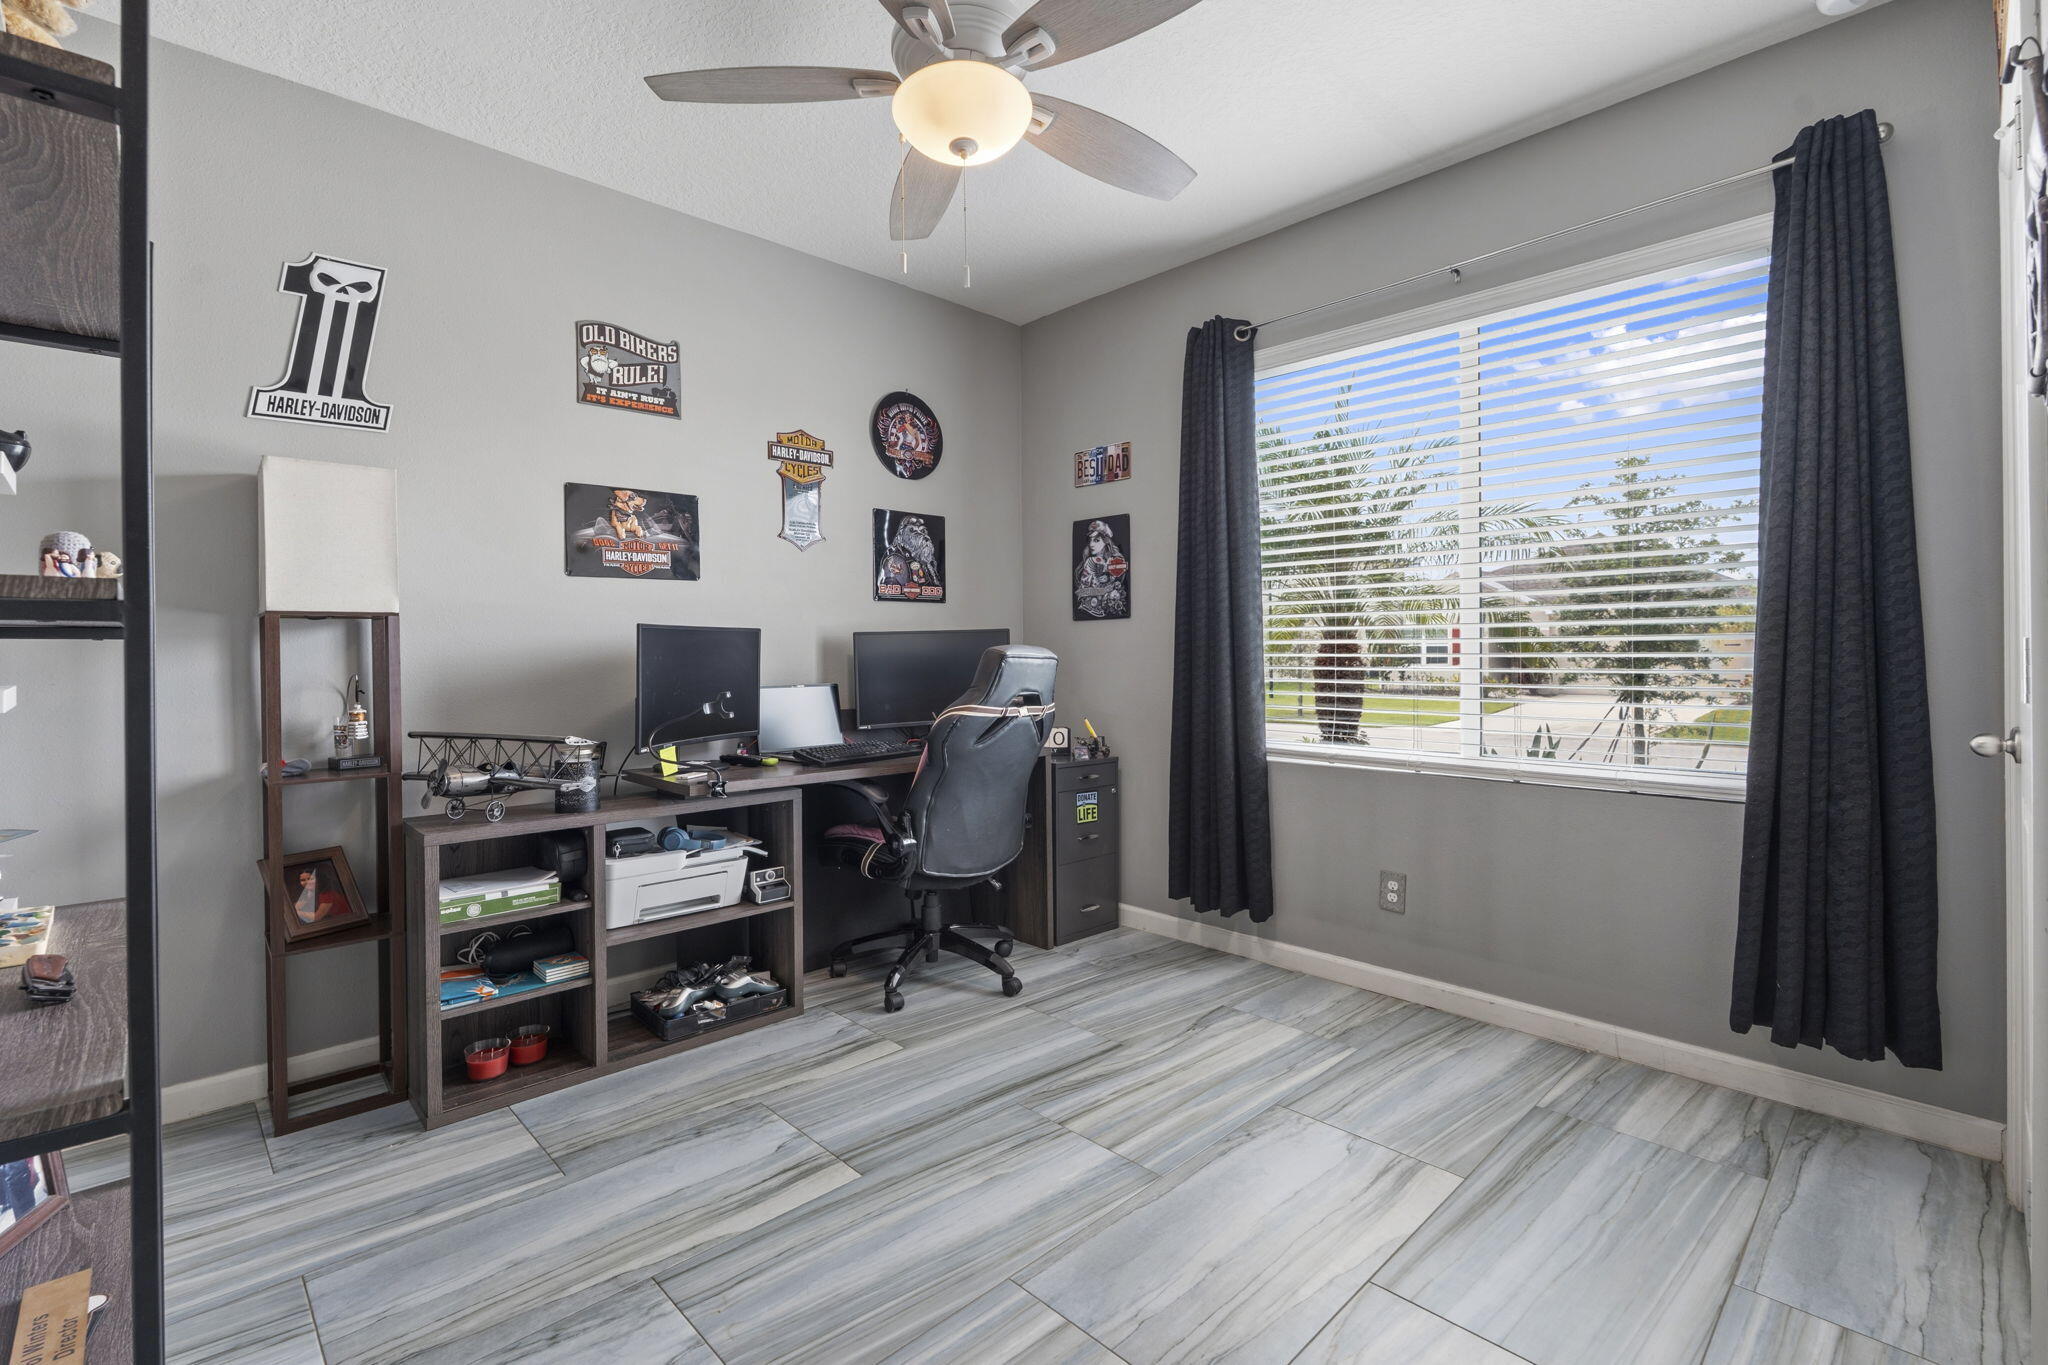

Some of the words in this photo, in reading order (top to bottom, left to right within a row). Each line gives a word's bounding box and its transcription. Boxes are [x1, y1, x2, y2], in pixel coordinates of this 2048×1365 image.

[582, 324, 616, 345] OLD
[619, 329, 678, 362] BIKERS
[612, 365, 664, 385] RULE!
[586, 394, 606, 403] IT'S
[609, 398, 674, 414] EXPERIENCE
[596, 387, 607, 396] IT
[610, 389, 638, 400] AIN'T
[640, 395, 665, 405] RUST
[267, 395, 381, 425] HARLEY-DAVIDSON
[787, 433, 818, 448] MOTOR
[772, 445, 830, 465] HARLEY-DAVIDSON
[784, 462, 819, 478] CYCLES
[1077, 454, 1104, 479] BEST
[1107, 453, 1129, 473] DAD
[605, 550, 668, 563] HARLEY-DAVIDSON
[878, 584, 901, 595] BAD
[1077, 792, 1097, 802] DONATE
[1078, 806, 1097, 821] LIFE
[22, 1313, 49, 1358] Winters
[52, 1315, 79, 1361] Director
